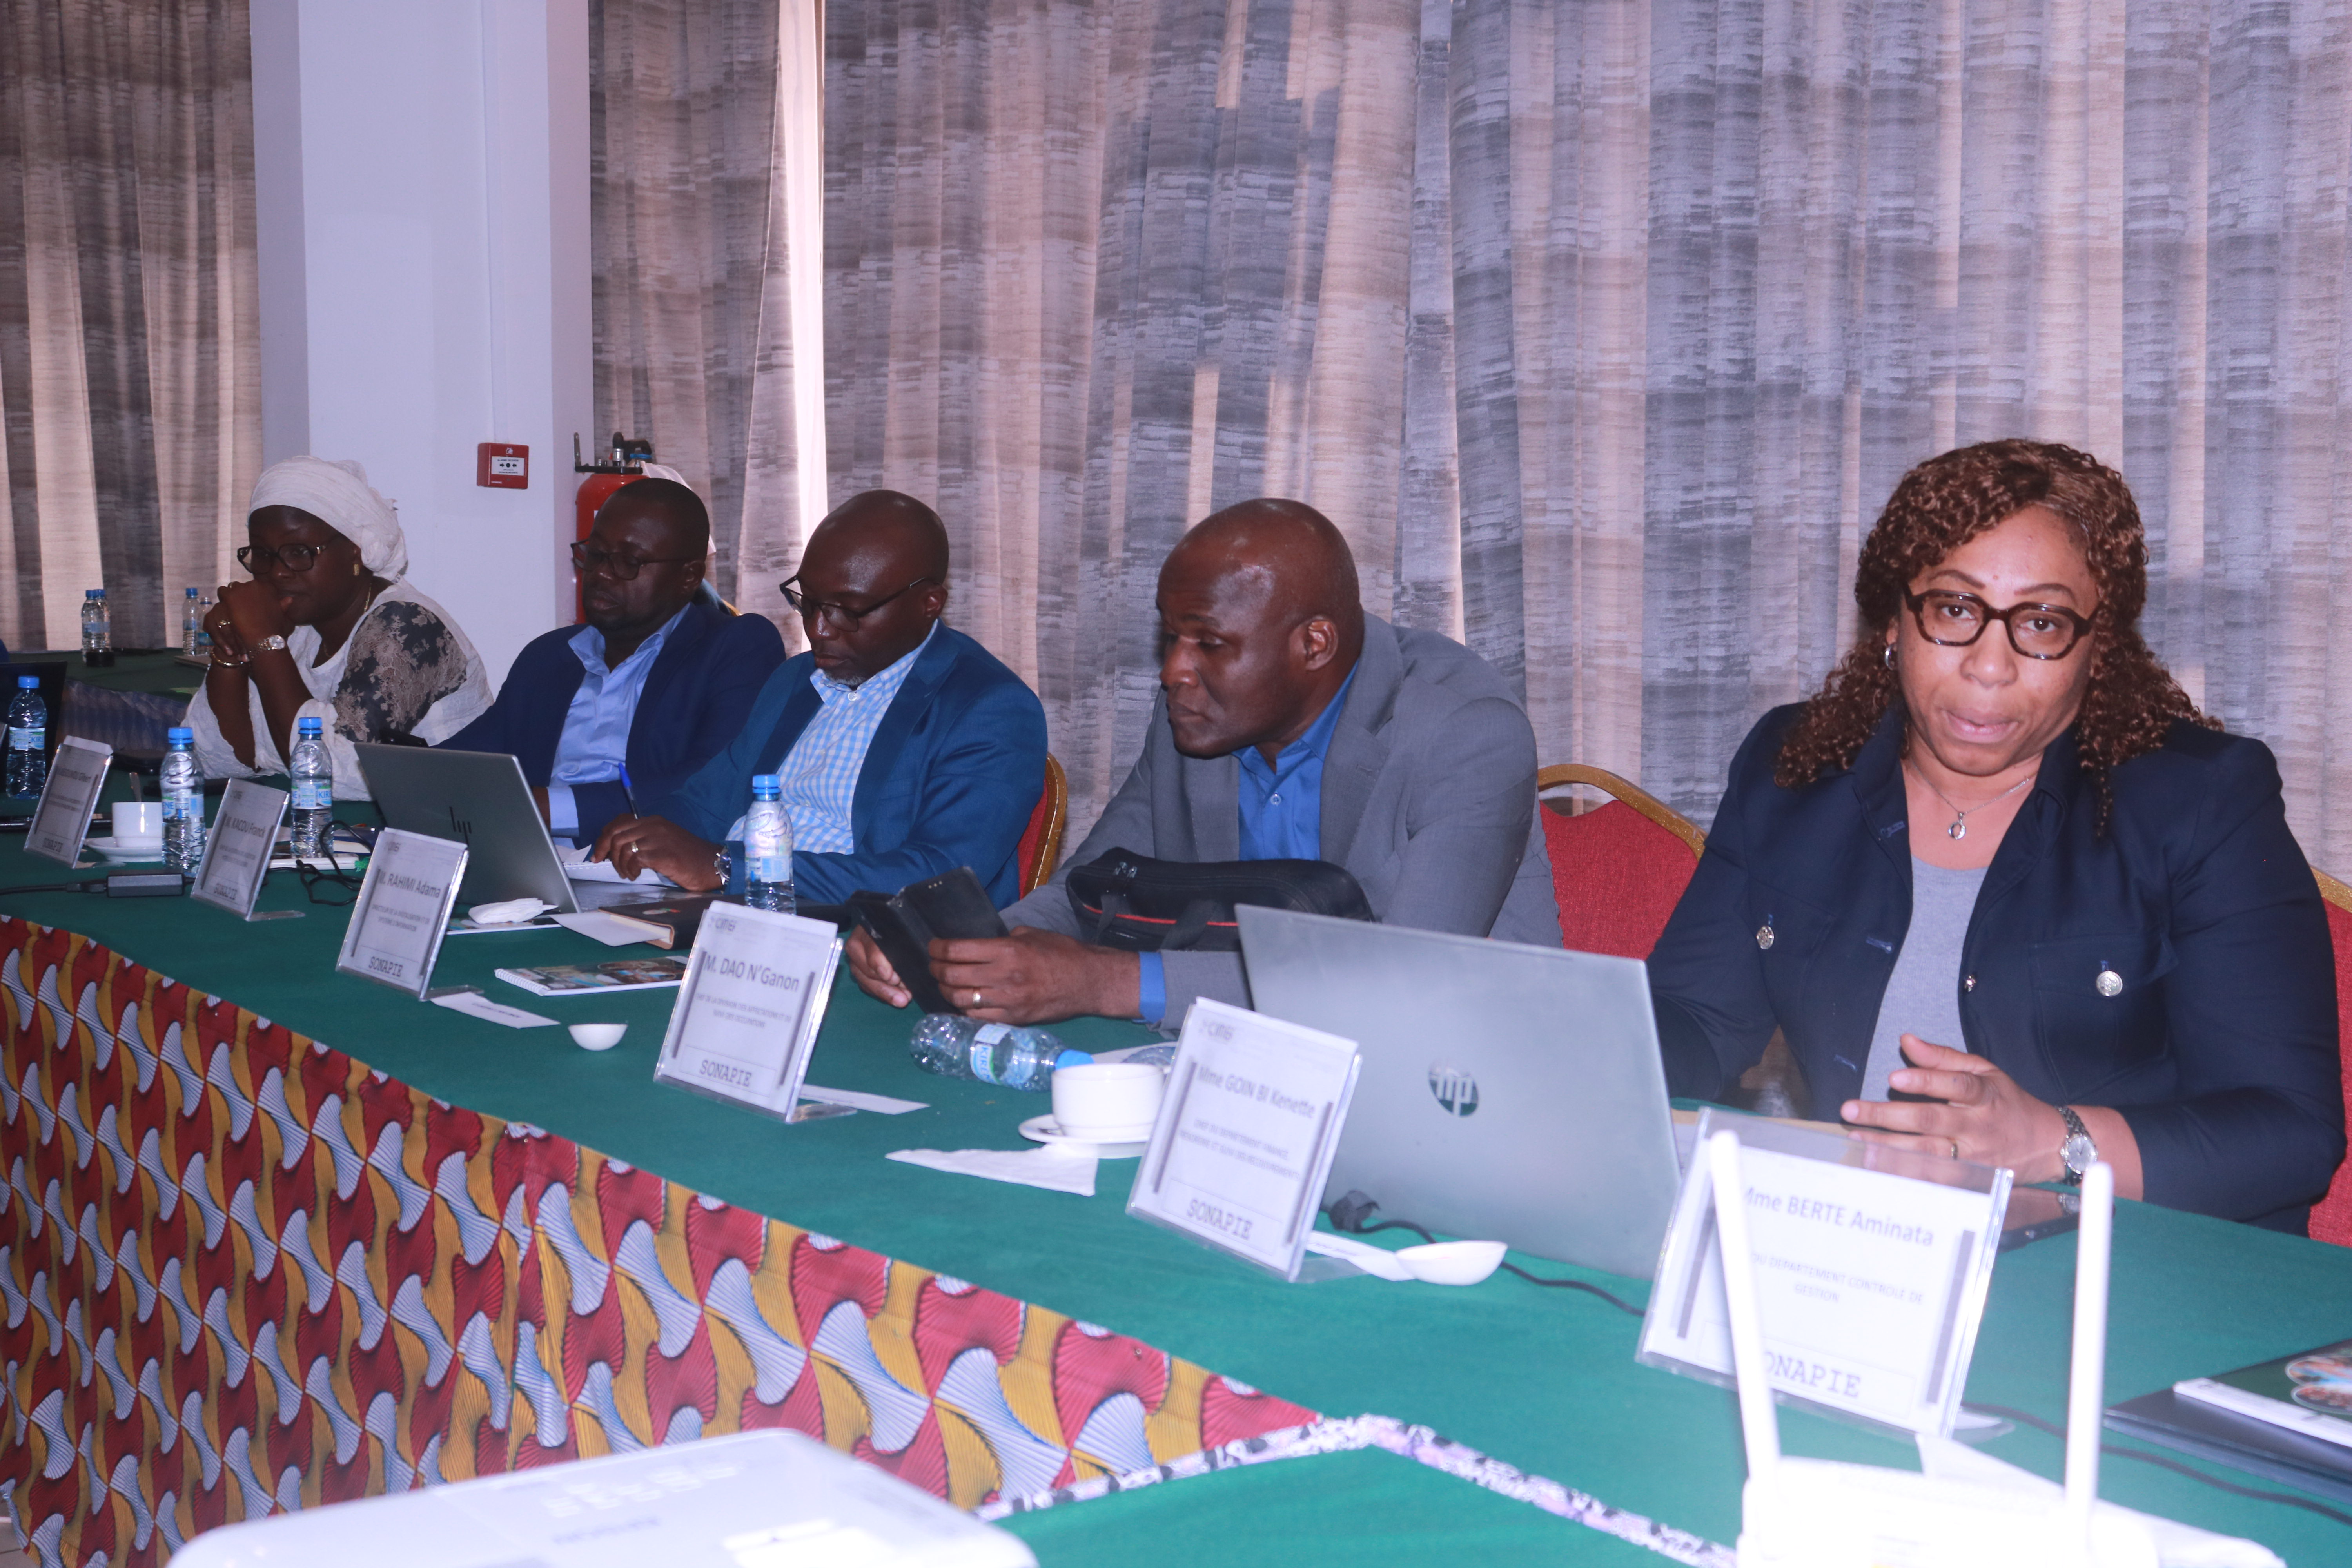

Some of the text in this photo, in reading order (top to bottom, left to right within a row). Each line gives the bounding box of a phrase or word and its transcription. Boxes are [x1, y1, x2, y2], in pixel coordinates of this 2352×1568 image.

[387, 873, 416, 891] RAHIMI
[414, 880, 441, 898] Adama
[368, 956, 403, 978] SONAPIE
[704, 955, 799, 991] M. DAO N'Ganon
[700, 1060, 751, 1087] SONAPIE
[1186, 1199, 1253, 1240] SONAPIE
[1788, 1196, 1846, 1226] BERTE
[1850, 1210, 1934, 1246] Aminata
[1769, 1257, 1845, 1284] DEPARTEMENT
[1907, 1290, 1923, 1304] DE
[1794, 1282, 1840, 1303] GESTION
[1764, 1351, 1862, 1399] ONAPIE
